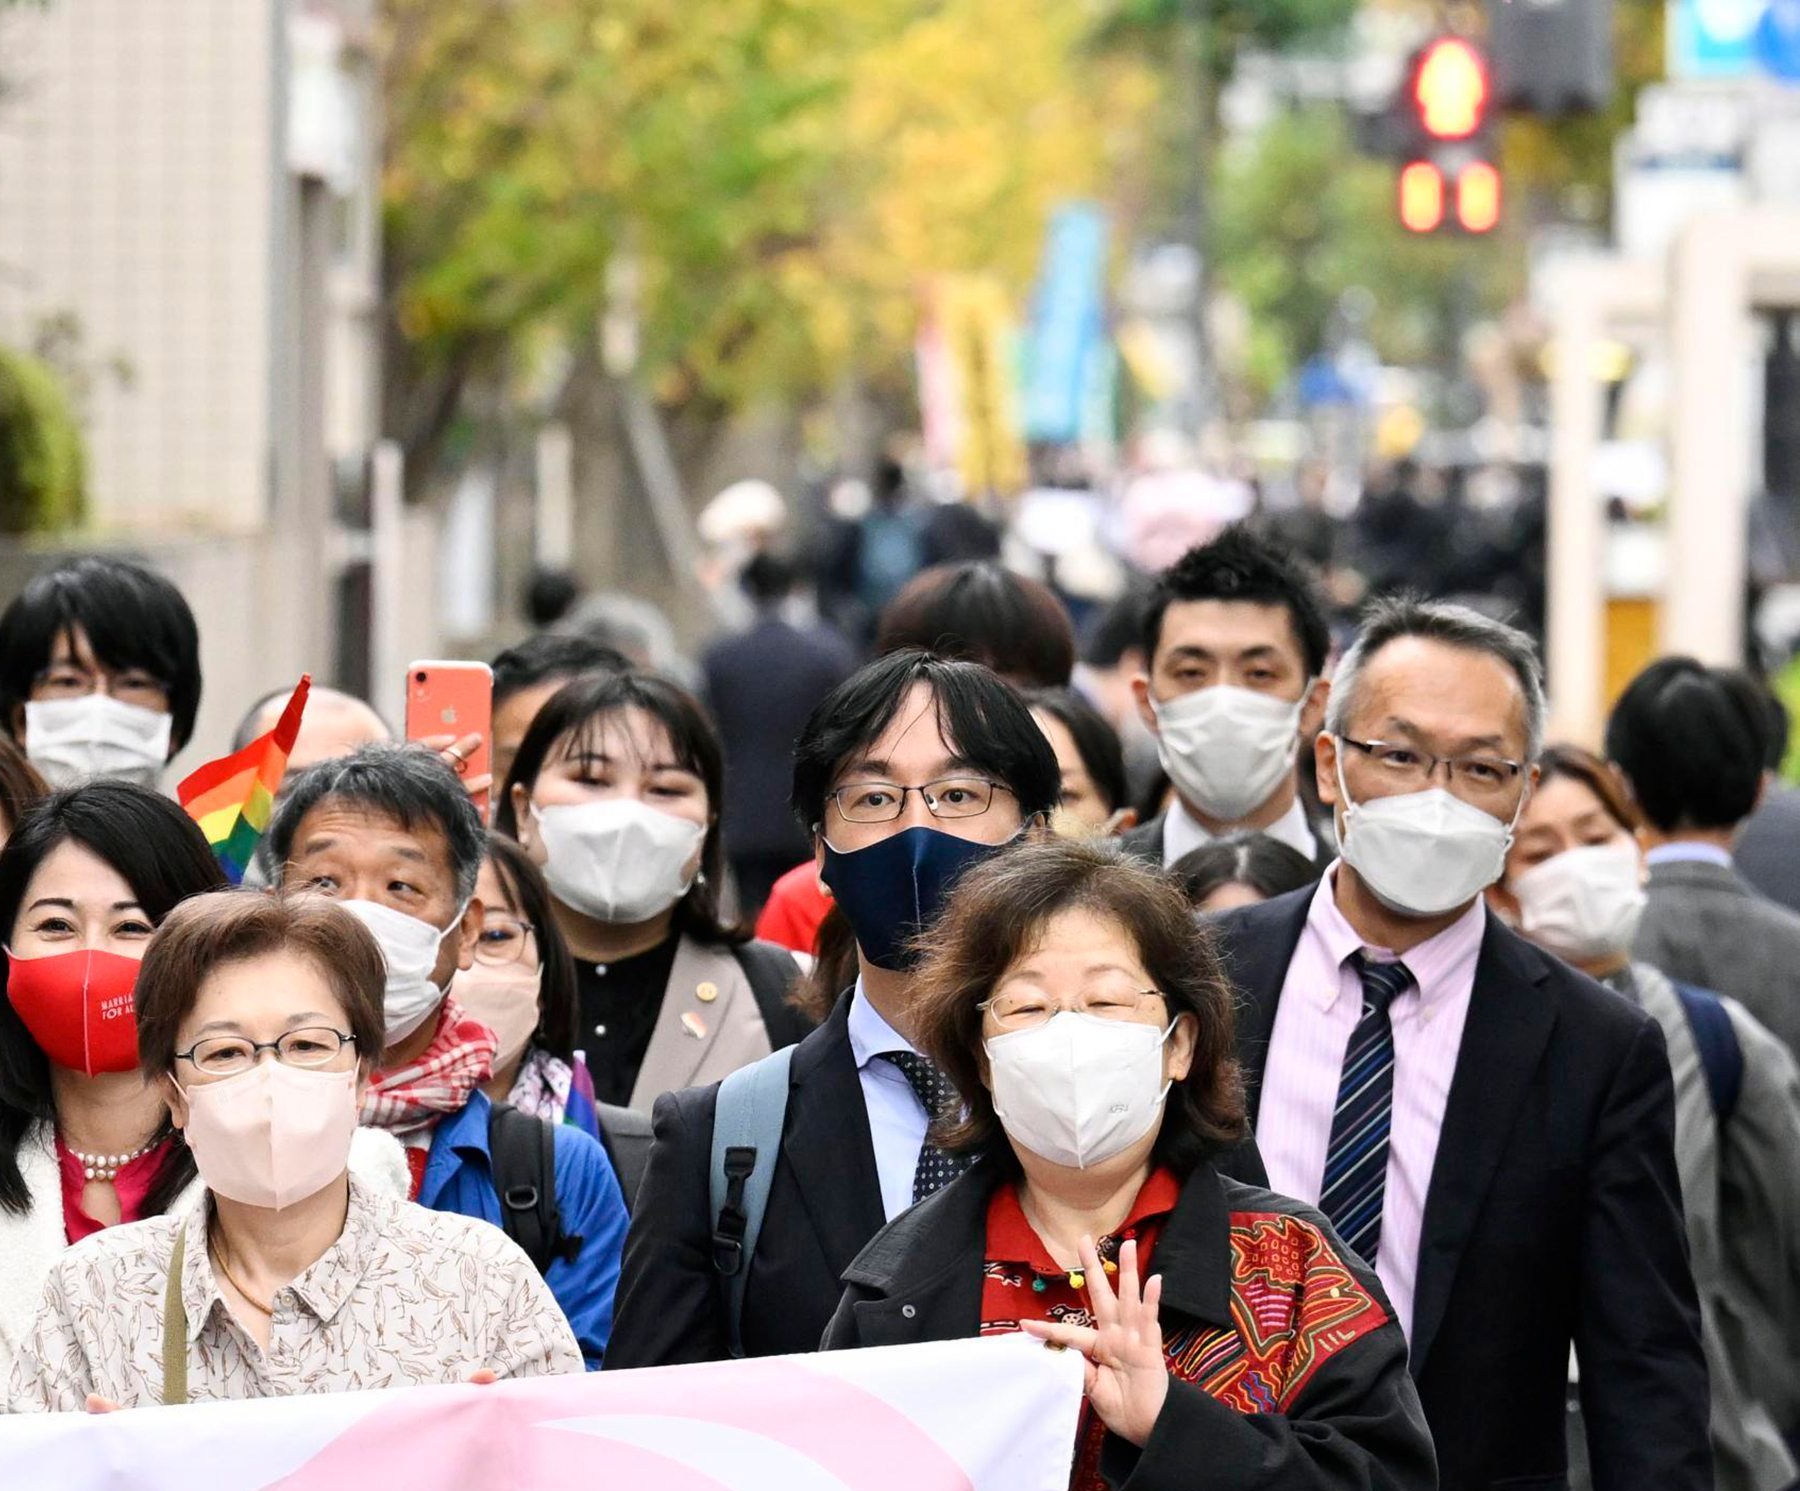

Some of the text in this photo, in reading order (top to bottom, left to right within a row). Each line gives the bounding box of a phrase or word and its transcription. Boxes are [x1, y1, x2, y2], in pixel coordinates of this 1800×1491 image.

[101, 993, 134, 1011] MARRIA
[102, 1004, 135, 1020] FOR AL
